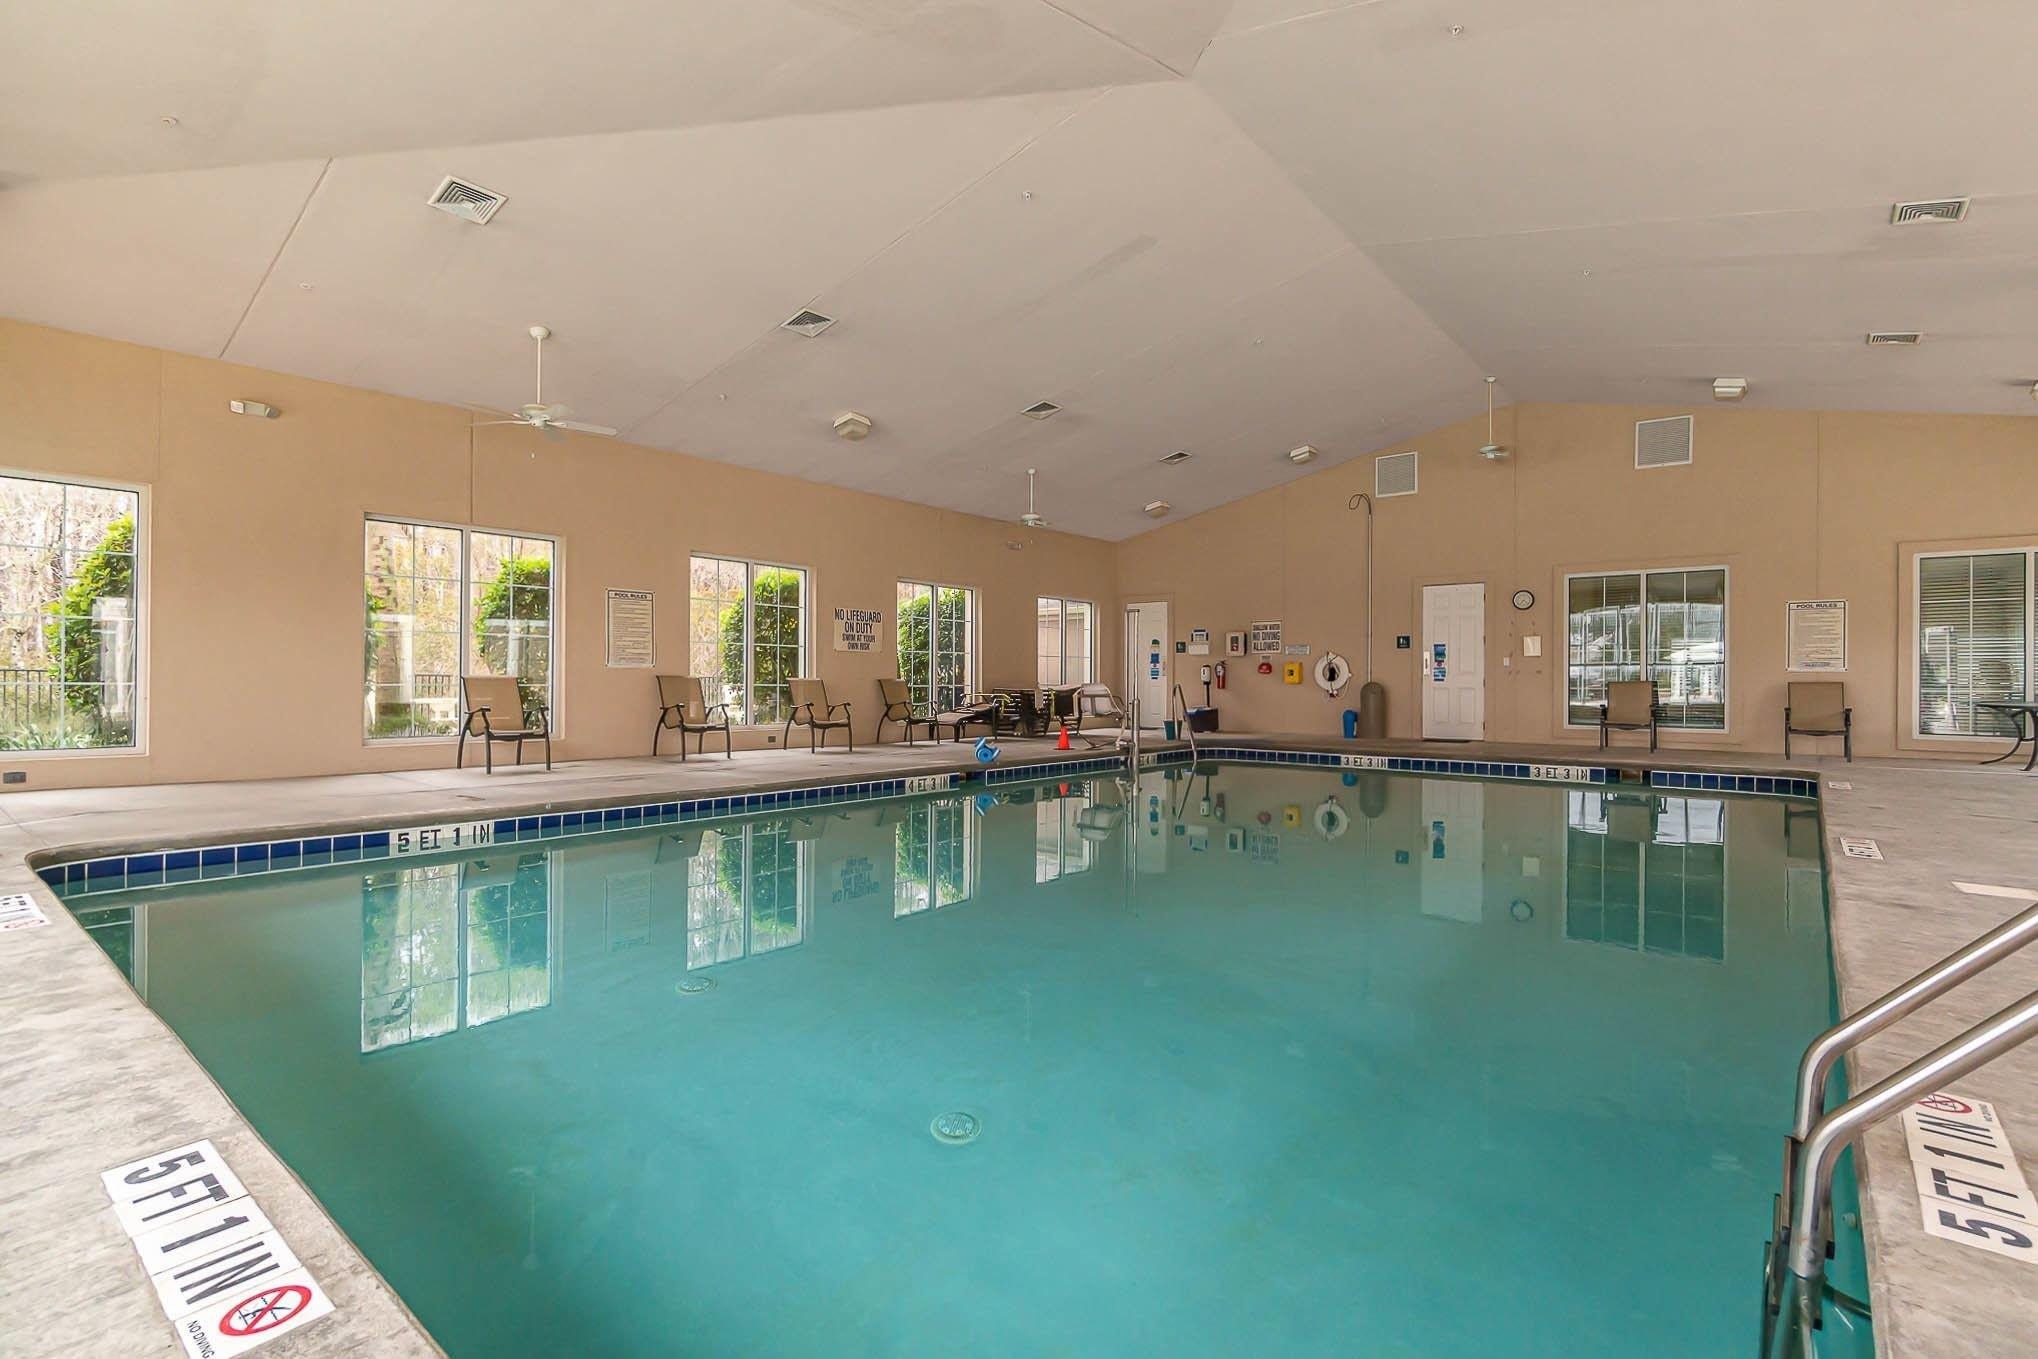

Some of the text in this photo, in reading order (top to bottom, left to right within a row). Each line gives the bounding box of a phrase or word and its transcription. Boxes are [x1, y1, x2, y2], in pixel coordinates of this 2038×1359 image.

[835, 608, 881, 623] NO LIFEGUARD
[845, 621, 872, 634] ON DUTY
[842, 633, 855, 642] SWIM
[863, 634, 875, 643] YOUR
[1253, 631, 1280, 640] NO DIVING
[848, 642, 859, 650] OWN
[1253, 641, 1279, 651] ALLOWED
[453, 827, 461, 846] 1
[1916, 1112, 2033, 1248] 5 FT 1 IN
[124, 1151, 280, 1305] 5 FT 1 IN
[187, 1320, 215, 1359] NO DIVING
